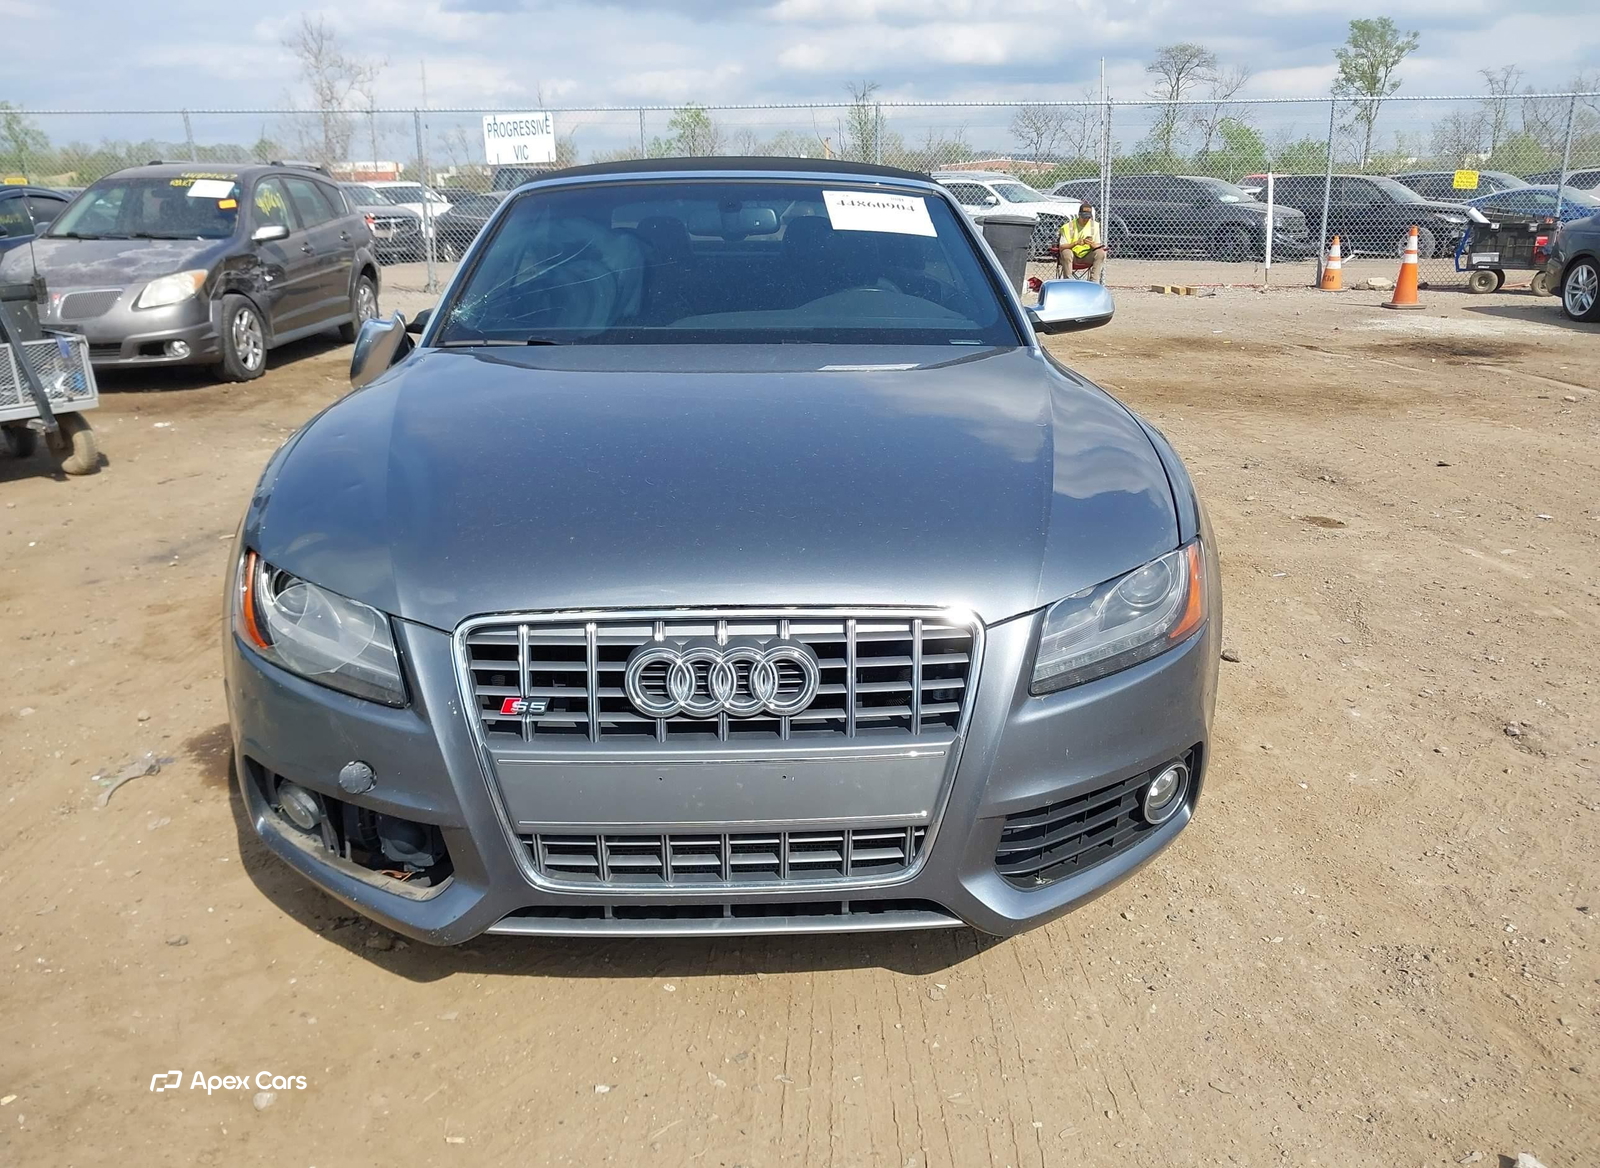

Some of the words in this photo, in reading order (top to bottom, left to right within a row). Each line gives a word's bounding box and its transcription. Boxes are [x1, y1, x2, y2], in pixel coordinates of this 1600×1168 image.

[487, 119, 551, 138] PROGRESSIVE
[513, 144, 529, 161] VIC
[510, 701, 546, 713] S5
